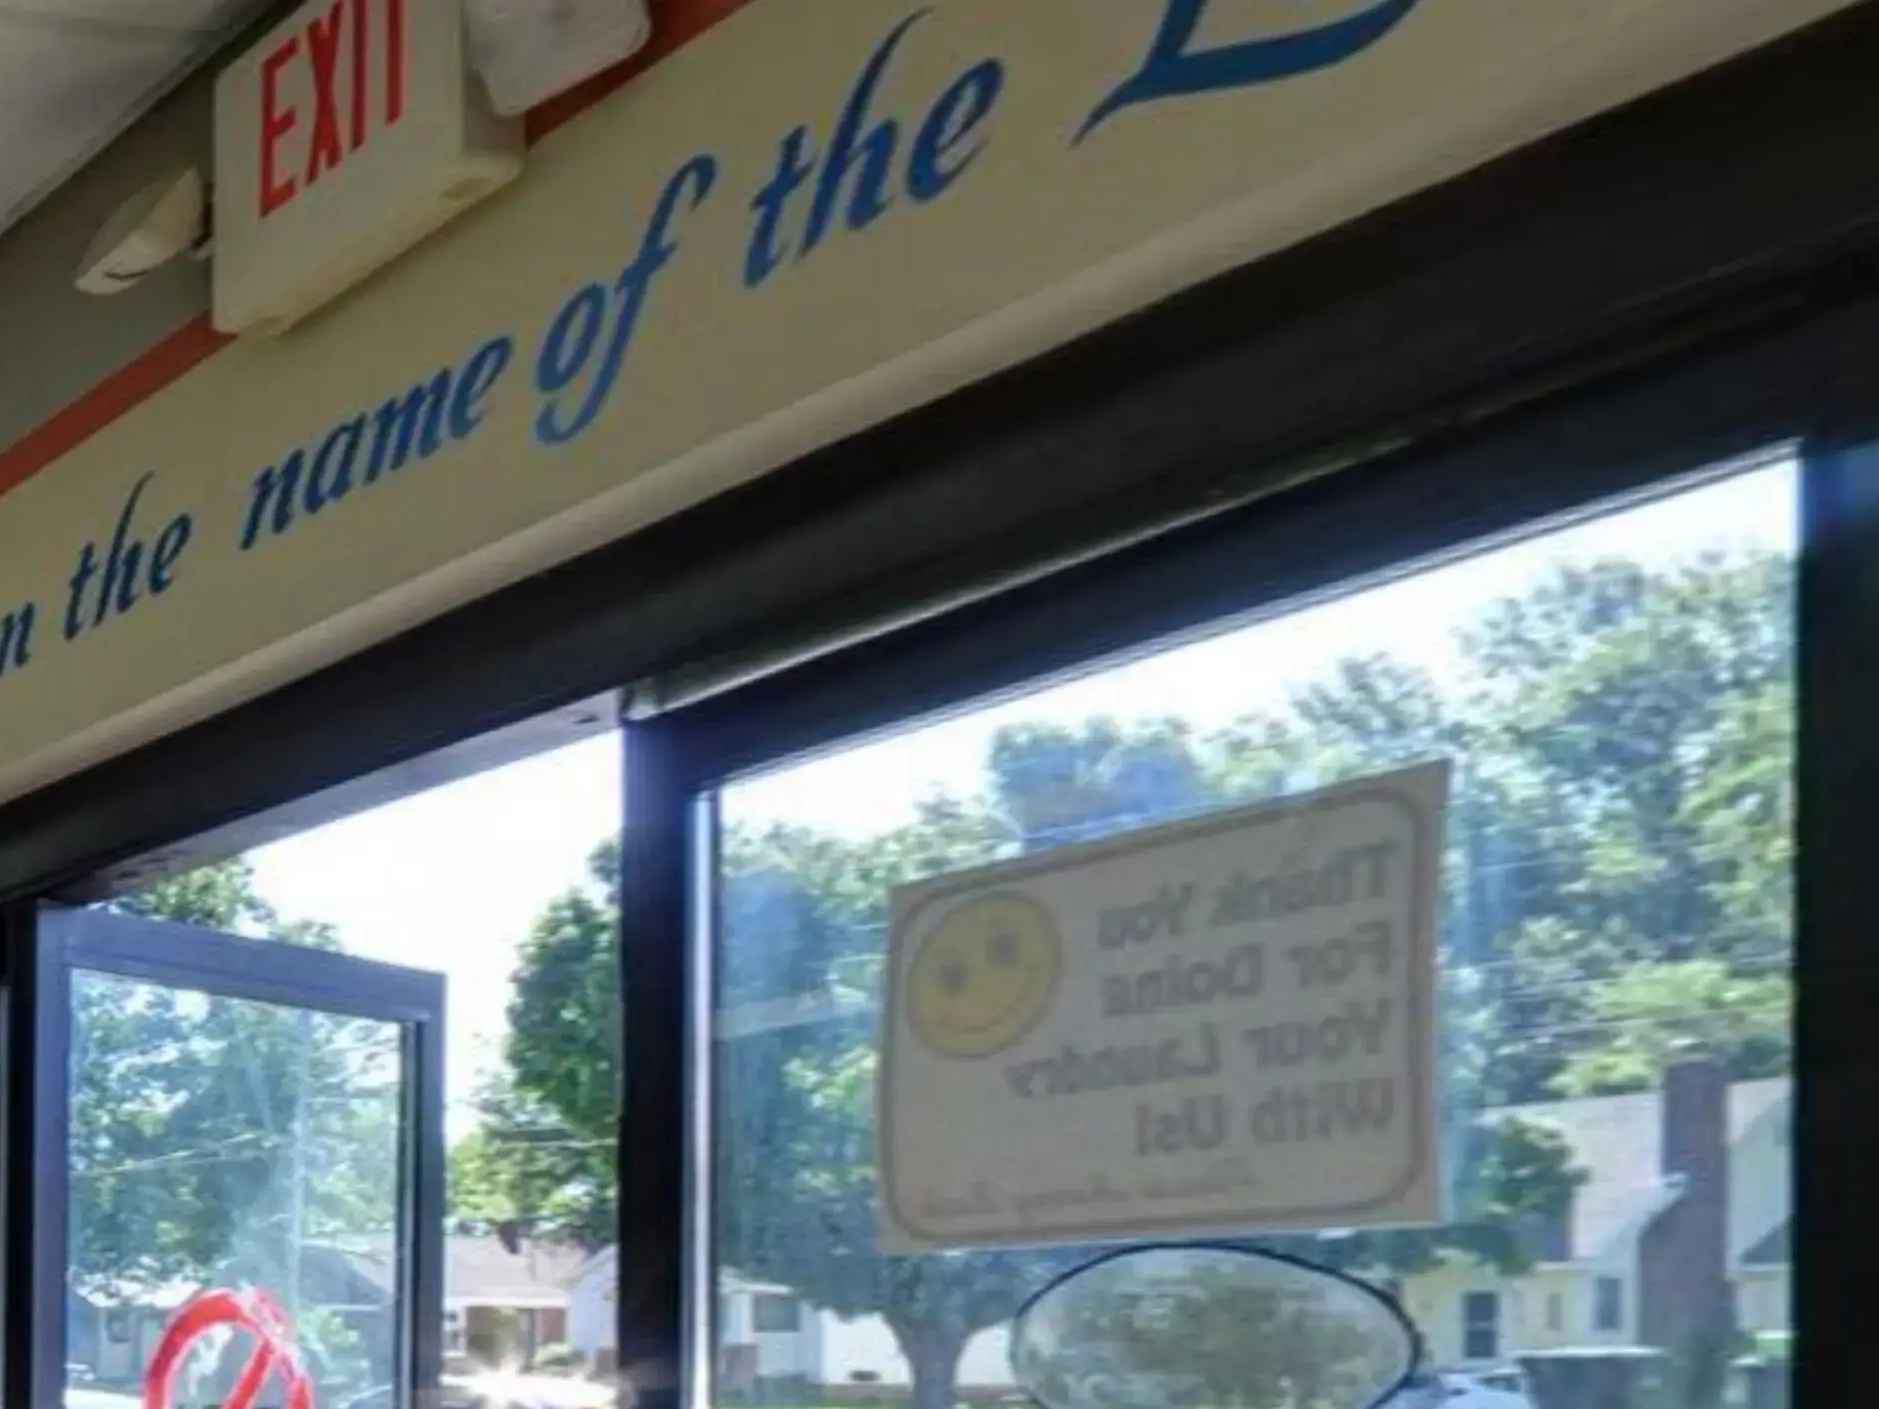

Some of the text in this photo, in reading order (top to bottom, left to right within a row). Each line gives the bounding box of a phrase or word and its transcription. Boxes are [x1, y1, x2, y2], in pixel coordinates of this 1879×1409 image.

[259, 0, 404, 217] EXIT
[63, 472, 193, 641] the
[239, 334, 514, 552] name
[533, 153, 719, 446] of
[741, 5, 1005, 289] the
